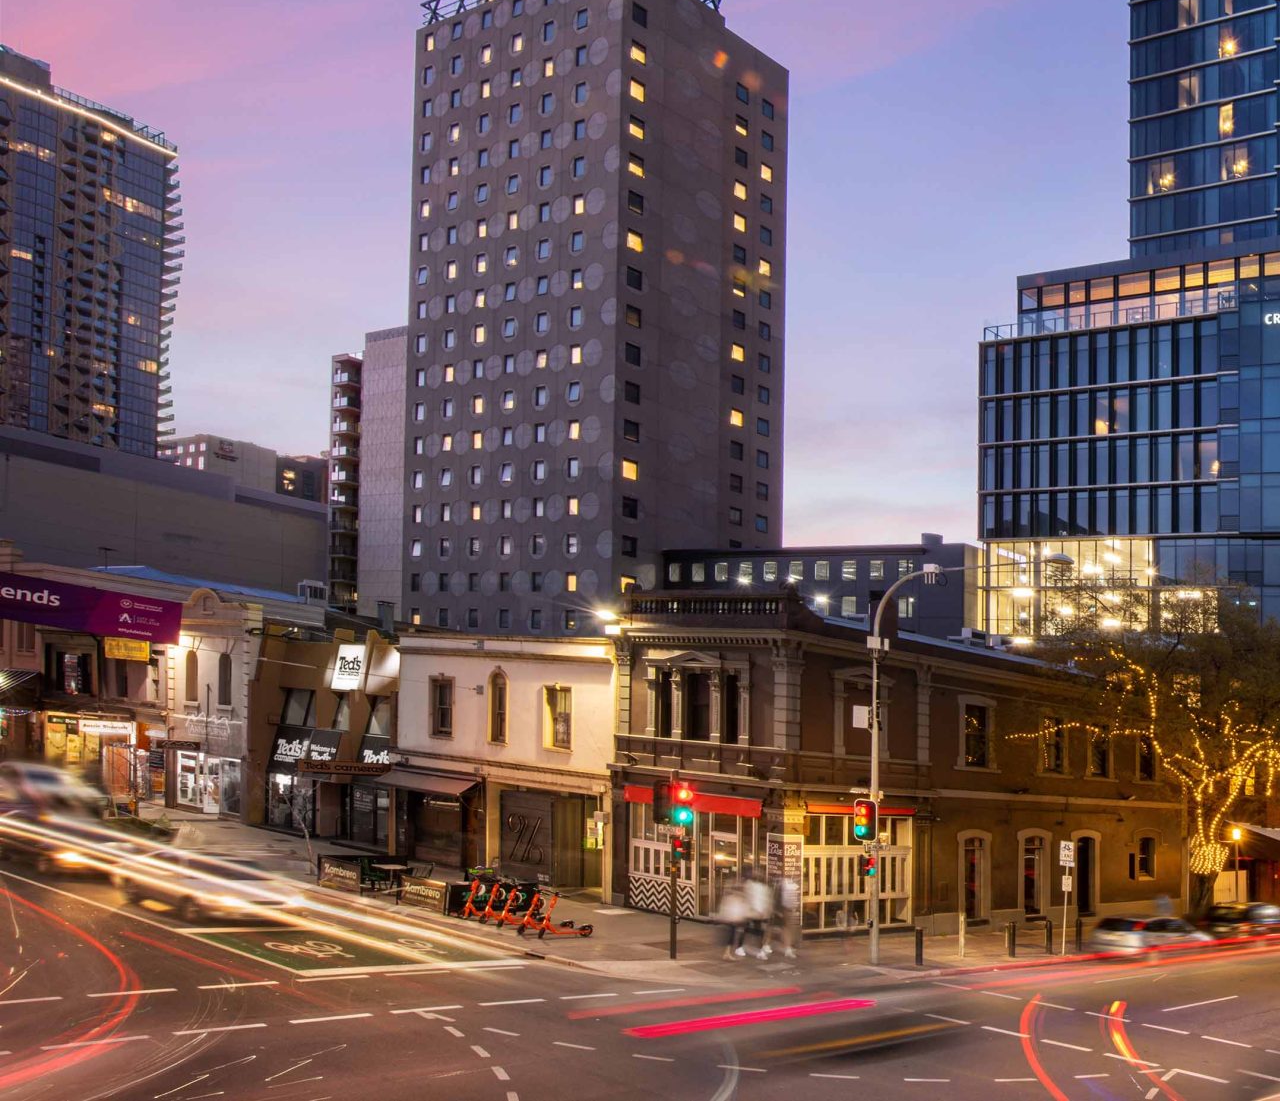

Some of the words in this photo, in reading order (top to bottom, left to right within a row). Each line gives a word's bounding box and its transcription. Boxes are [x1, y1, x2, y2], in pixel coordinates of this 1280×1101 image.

[0, 586, 61, 607] ends
[338, 656, 362, 672] Ted's
[277, 738, 303, 757] Ted's
[304, 761, 331, 771] Ted's
[334, 763, 385, 773] cameras
[324, 863, 357, 880] Zambrero
[405, 882, 440, 899] Zambrero
